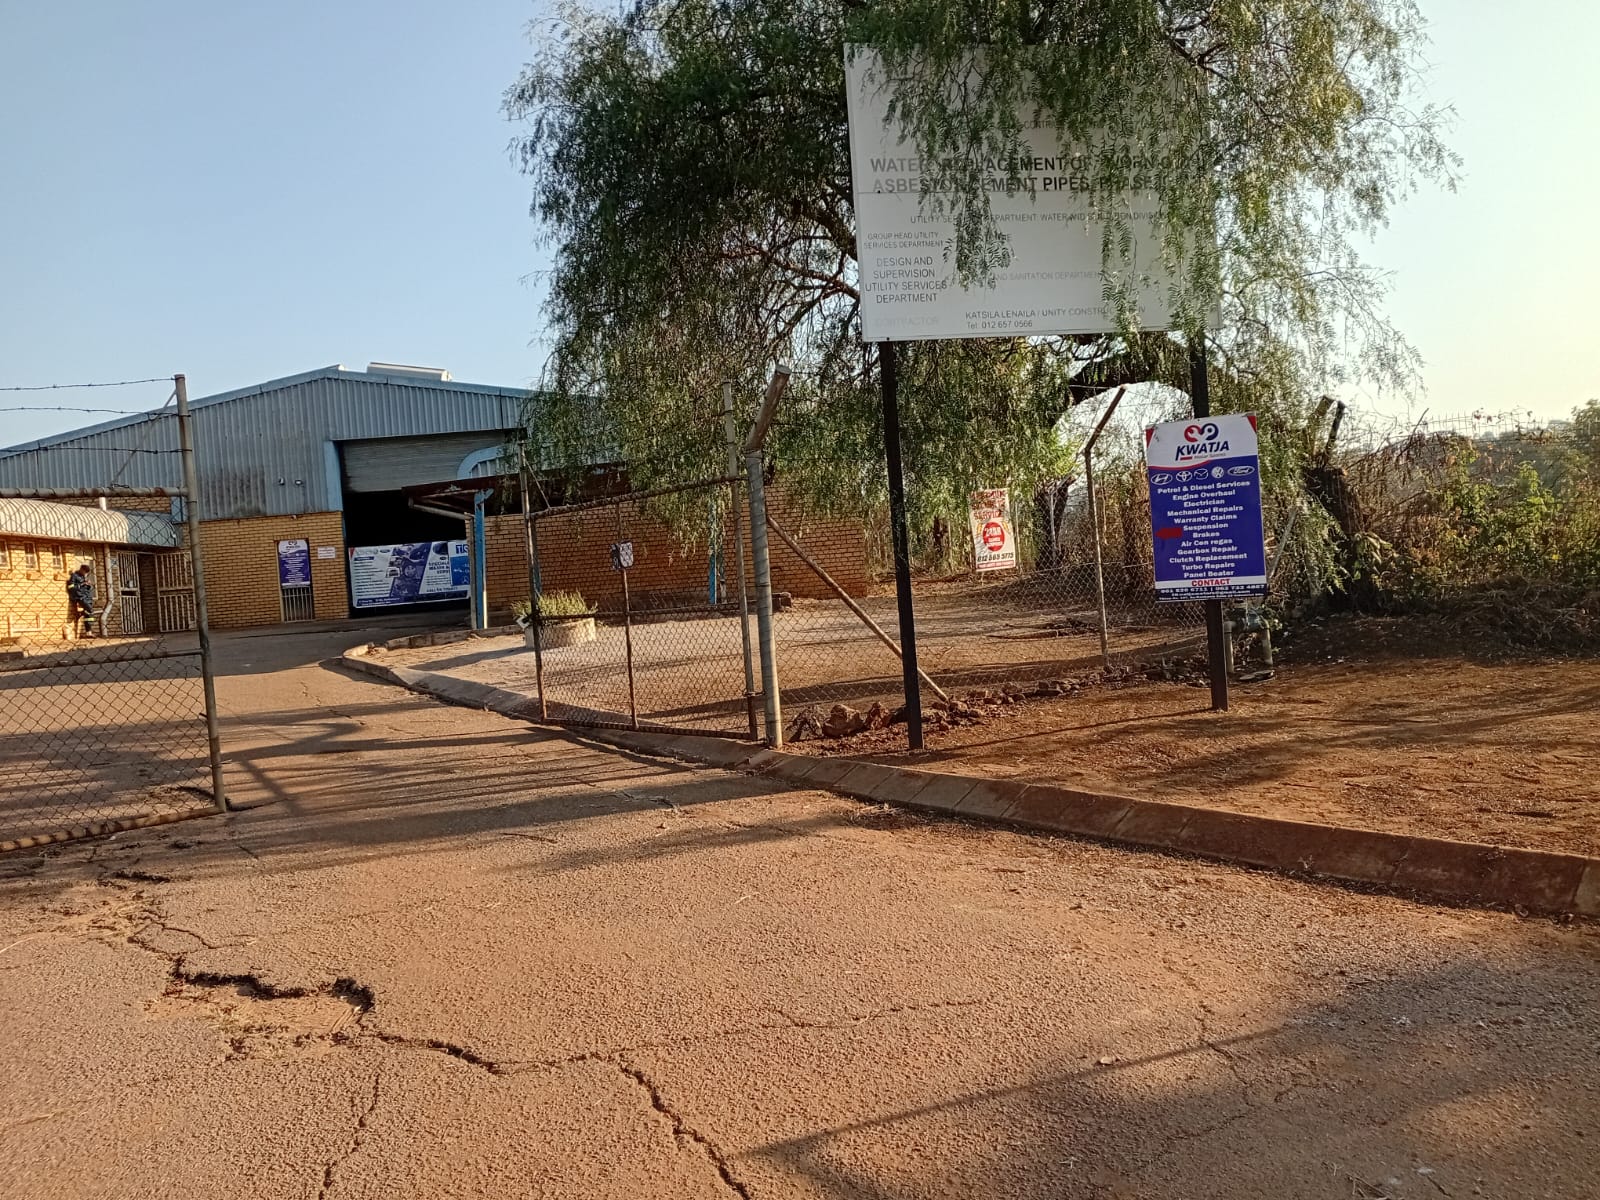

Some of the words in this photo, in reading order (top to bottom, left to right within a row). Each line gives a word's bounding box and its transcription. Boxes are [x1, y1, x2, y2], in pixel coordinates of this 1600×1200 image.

[968, 177, 1038, 192] EMENT
[984, 214, 1037, 223] EPARTMENT
[867, 232, 893, 240] GROUP
[894, 232, 913, 240] HEAD
[914, 231, 939, 239] UTILITY
[864, 241, 898, 249] SERVICES
[900, 240, 943, 248] DEPARTMENT
[876, 256, 912, 267] DESIGN
[914, 256, 933, 266] AND
[873, 268, 936, 279] SUPERVISION
[1055, 271, 1105, 280] DEPARTMEN
[865, 281, 899, 292] UTILITY
[901, 280, 948, 291] SERVICES
[876, 292, 938, 304] DEPARTMENT
[1042, 307, 1066, 317] UNITY
[1175, 440, 1230, 461] KWATJA
[1190, 483, 1215, 491] Diesel
[1216, 481, 1251, 489] Services
[1172, 493, 1199, 501] Engine
[1200, 489, 1236, 498] Overhaul
[1183, 499, 1225, 508] Electrician
[1167, 507, 1212, 517] Mechanical
[1213, 505, 1244, 514] Repairs
[1174, 515, 1209, 524] Warranty
[1210, 513, 1238, 521] Claims
[1183, 522, 1229, 531] Suspension
[1192, 531, 1220, 539] Brakes
[1194, 539, 1209, 547] Con
[1210, 539, 1233, 547] regas
[1177, 547, 1210, 556] Gearbox
[1211, 546, 1238, 554] Repair
[1169, 555, 1194, 564] Clutch
[1195, 553, 1248, 562] Replacement
[1182, 563, 1203, 571] Turbo
[1204, 562, 1235, 570] Repairs
[1183, 571, 1206, 579] Panel
[1207, 570, 1234, 578] Beater
[1191, 578, 1231, 587] CONTACT
